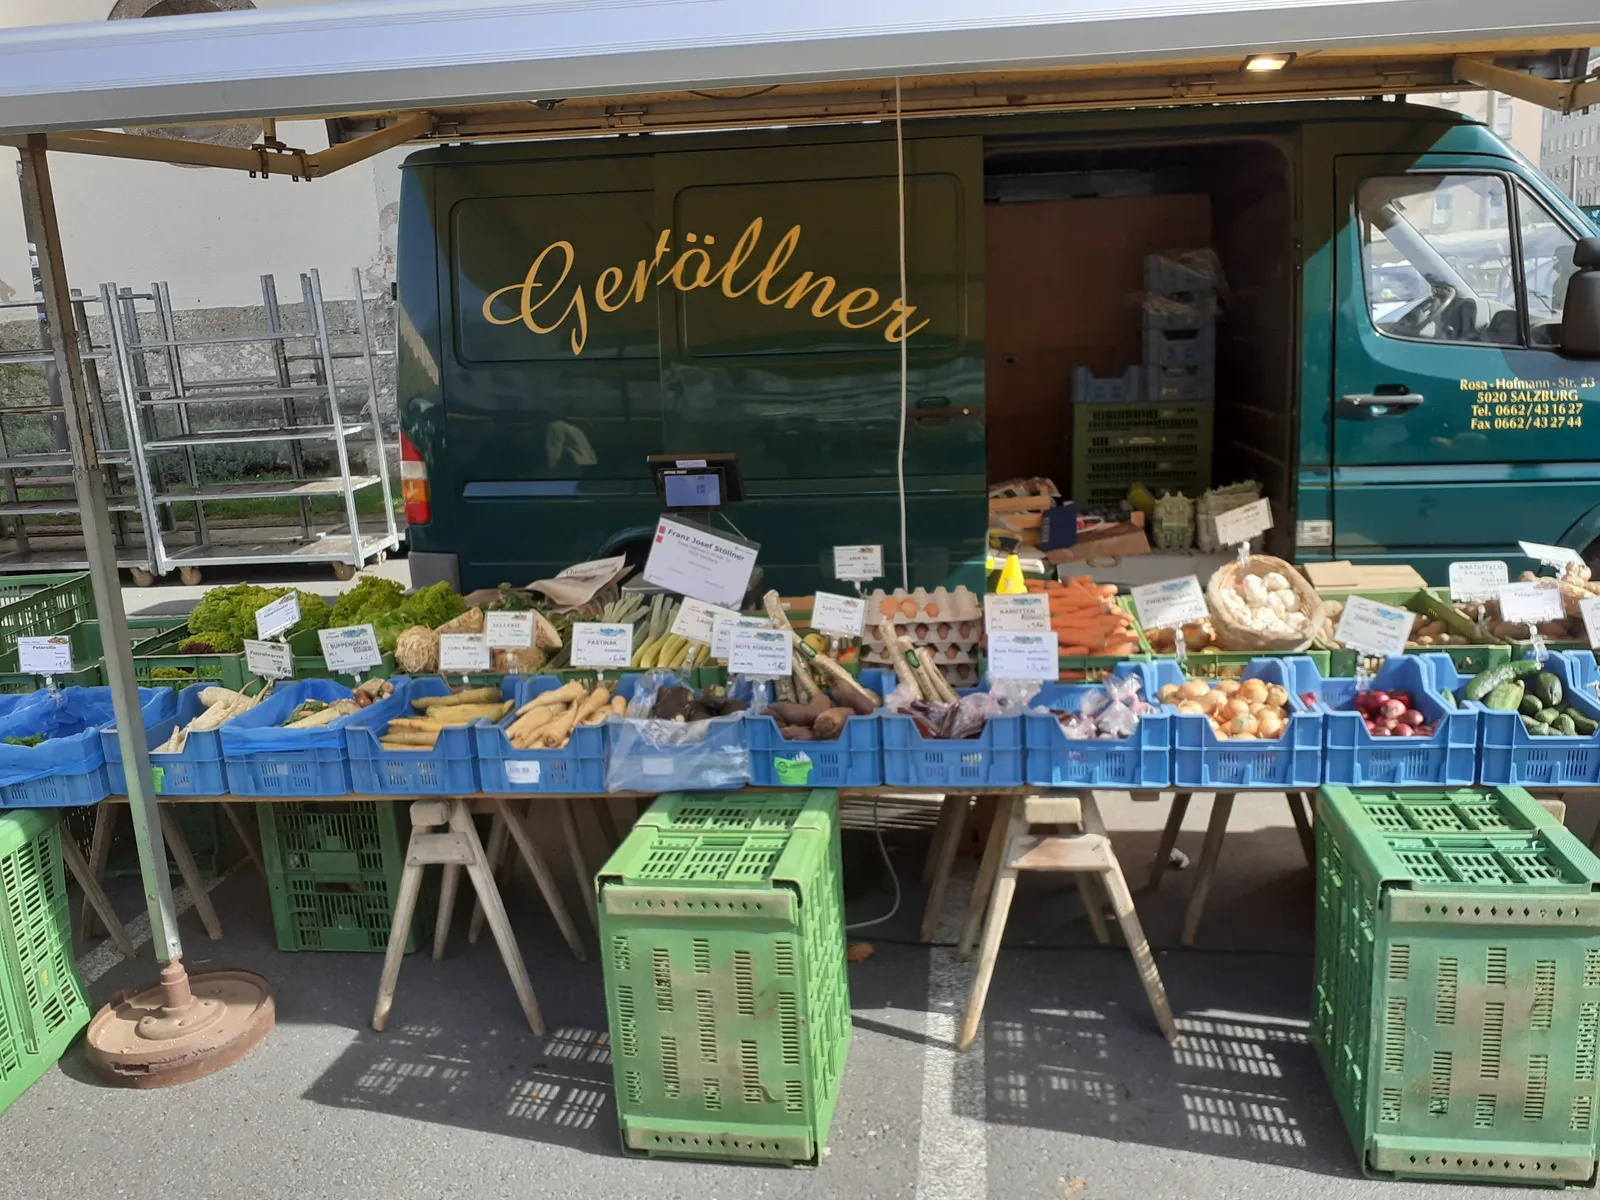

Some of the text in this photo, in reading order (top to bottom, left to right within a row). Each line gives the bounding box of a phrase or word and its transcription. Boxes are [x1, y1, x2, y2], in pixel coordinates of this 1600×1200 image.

[1580, 376, 1596, 388] 23
[1476, 389, 1579, 403] 5020 SALZBURG
[1471, 404, 1491, 416] Tel.
[1470, 418, 1491, 430] Fax
[667, 528, 690, 541] Franz
[692, 537, 714, 550] Josef
[714, 545, 746, 561] Stöllner
